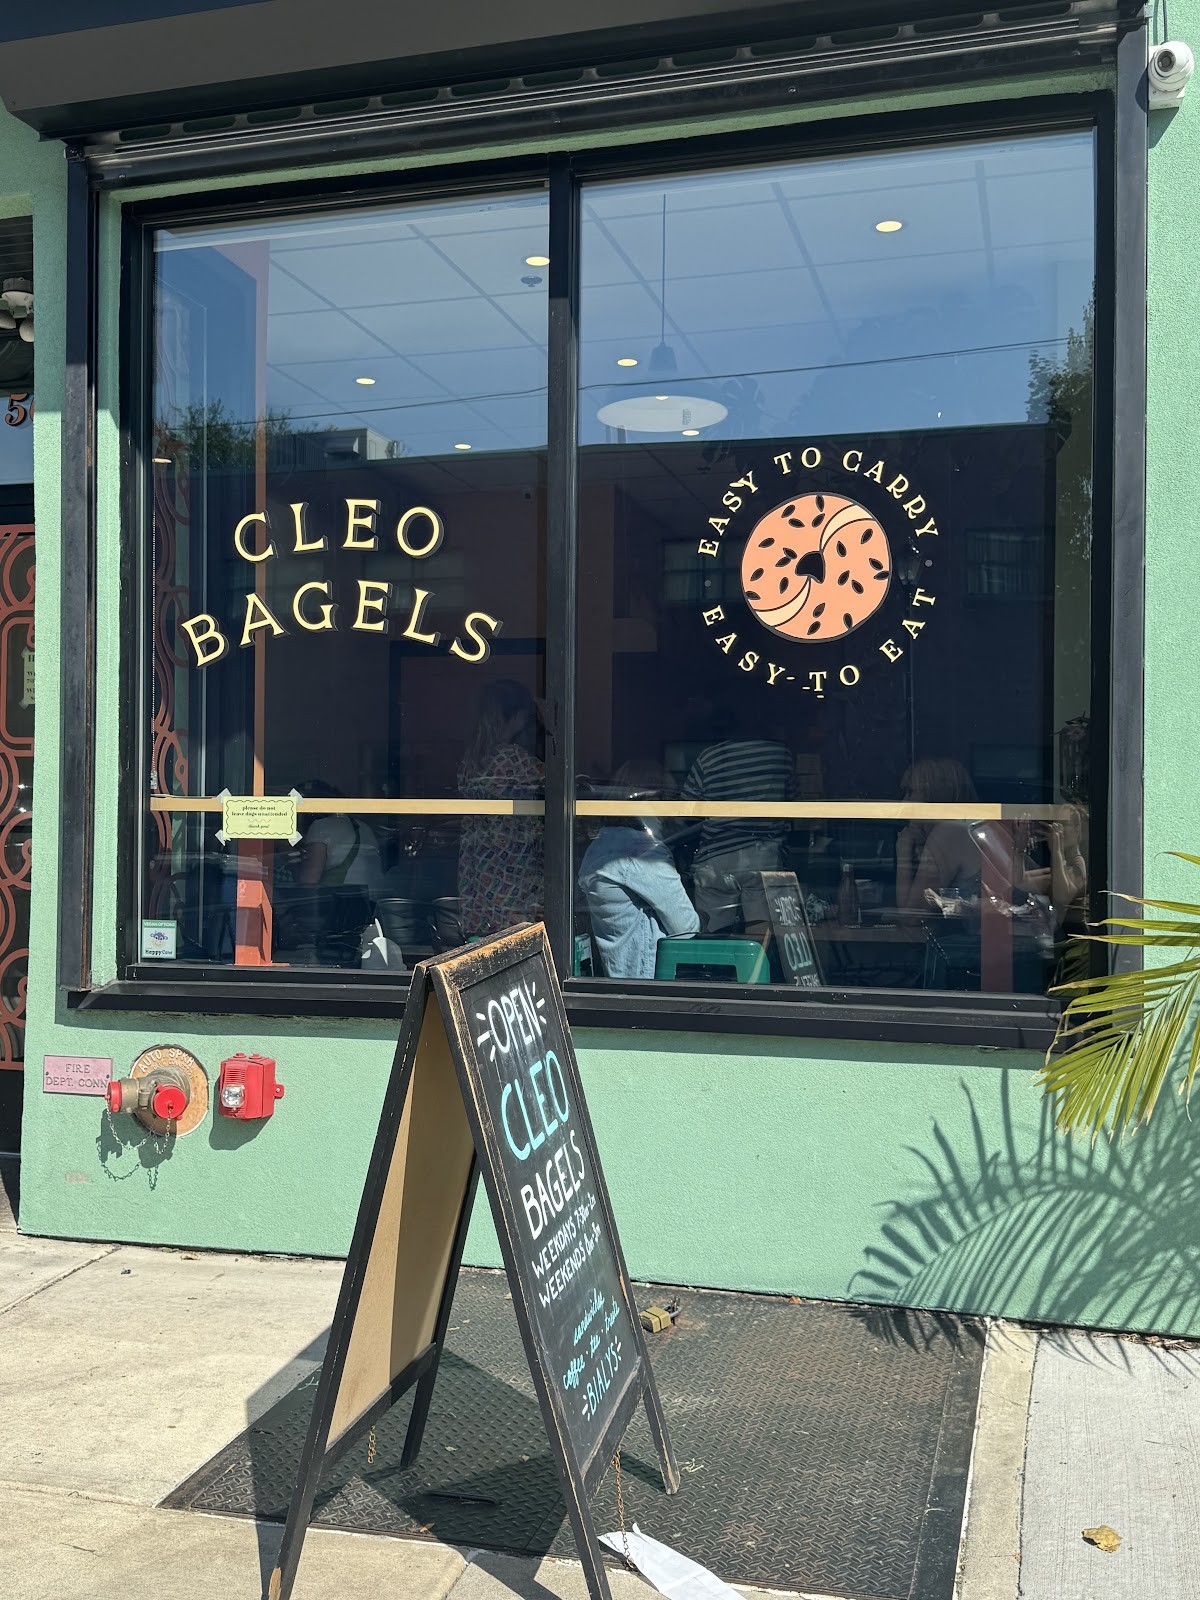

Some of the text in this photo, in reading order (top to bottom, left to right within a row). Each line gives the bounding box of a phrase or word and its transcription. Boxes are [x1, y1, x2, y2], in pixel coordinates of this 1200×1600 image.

[5, 393, 34, 426] 5
[234, 498, 444, 562] CLEO
[698, 447, 939, 557] EASY TO CARRY
[181, 579, 503, 668] BAGELS
[702, 588, 936, 692] EASY TO EAT
[488, 984, 542, 1054] OPEN
[45, 1076, 74, 1087] DEPT.
[65, 1063, 91, 1074] FIRE
[501, 1050, 569, 1161] CLEO
[521, 1129, 585, 1240] BAGELS
[531, 1215, 577, 1279] WEEKDAYS
[539, 1240, 586, 1308] WEEKENDS
[563, 1353, 586, 1390] coffee
[587, 1342, 619, 1416] BIALYS
